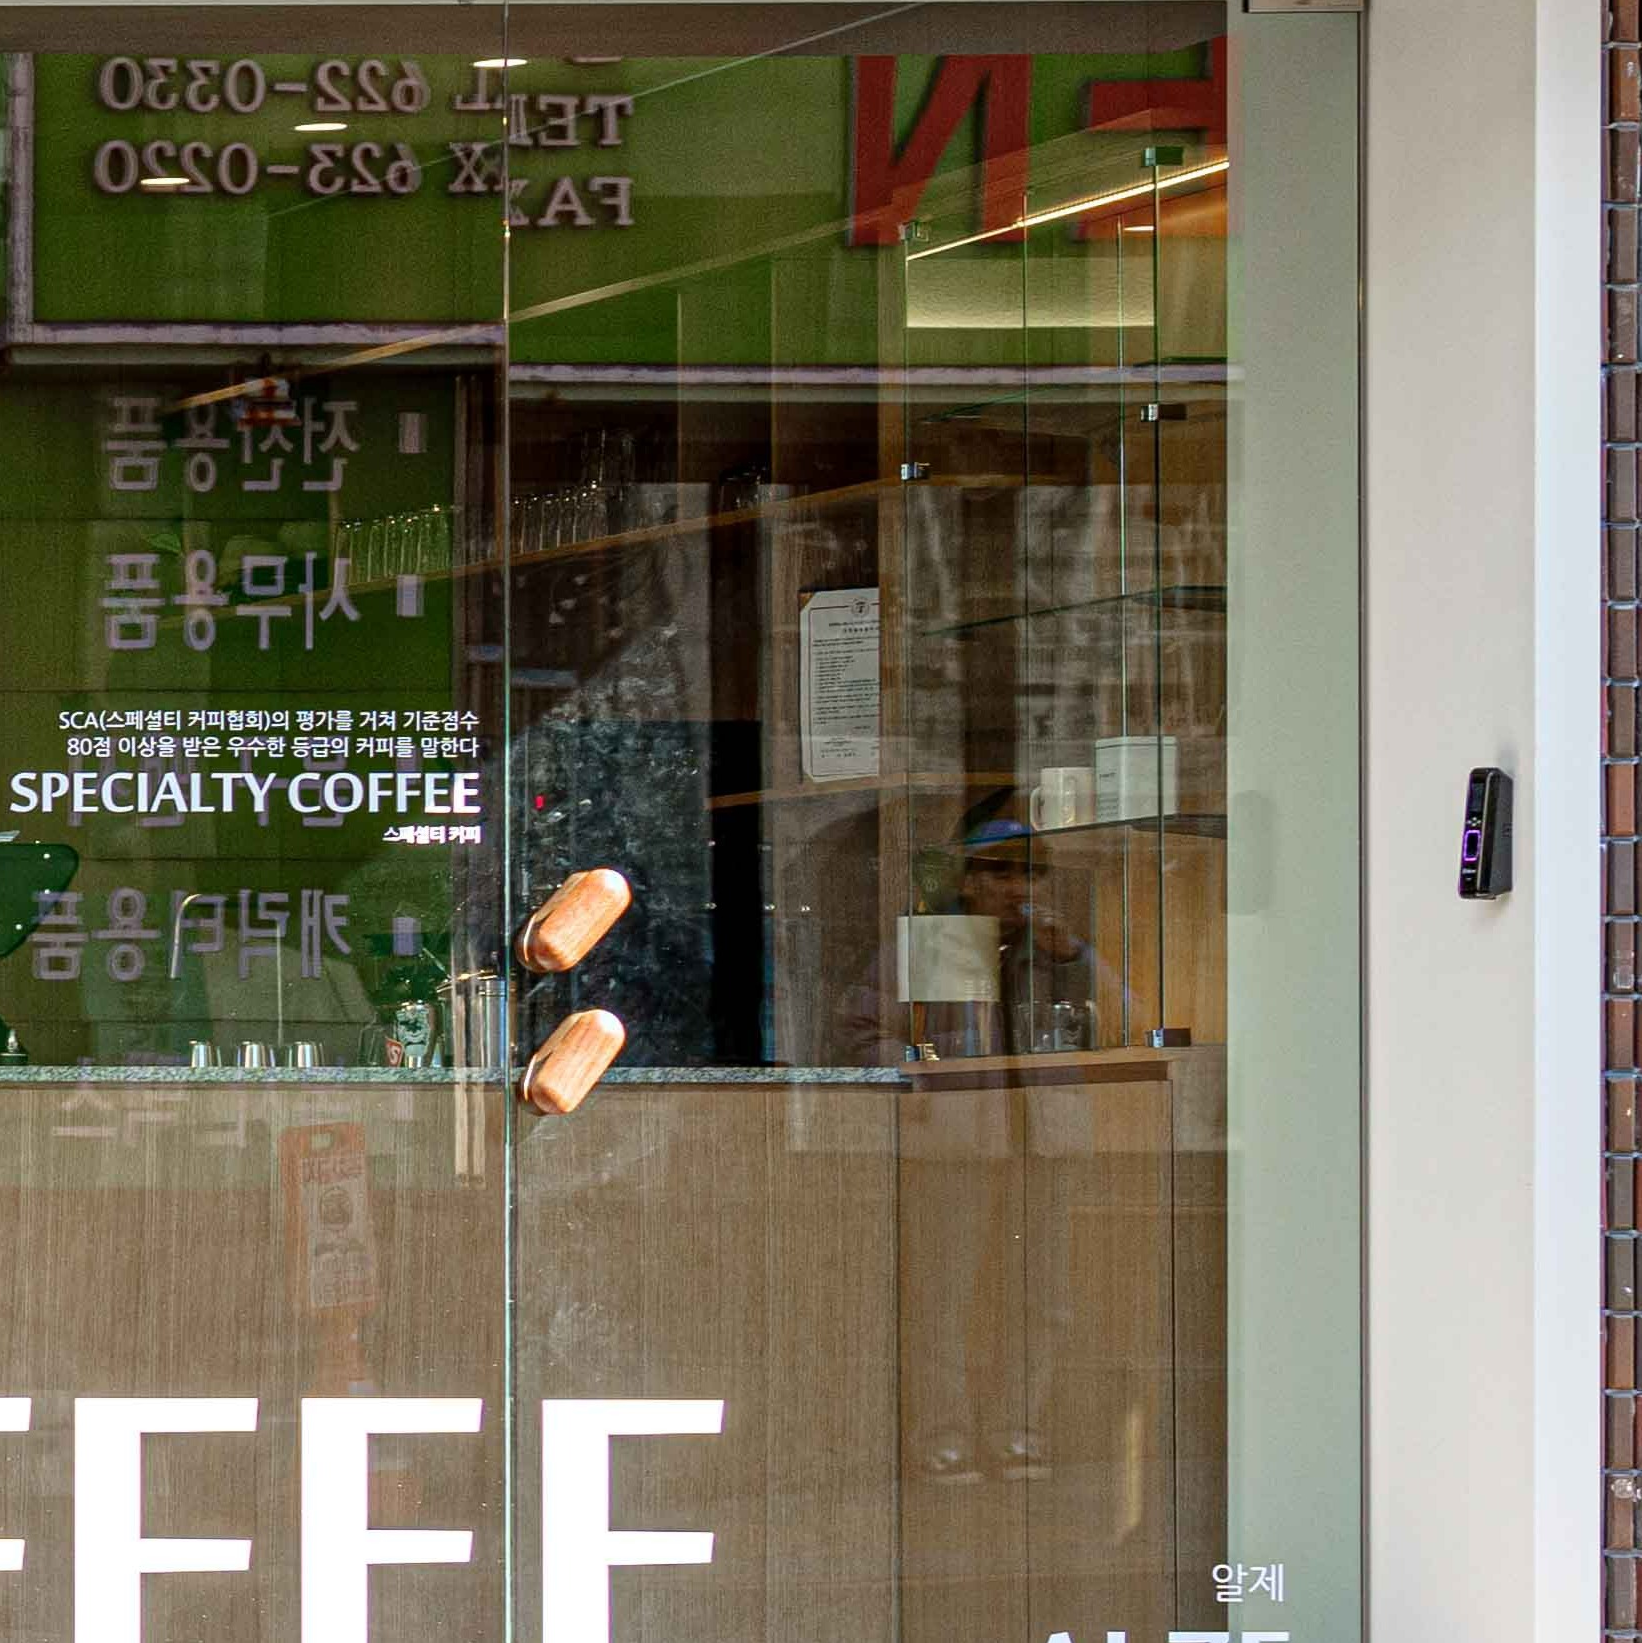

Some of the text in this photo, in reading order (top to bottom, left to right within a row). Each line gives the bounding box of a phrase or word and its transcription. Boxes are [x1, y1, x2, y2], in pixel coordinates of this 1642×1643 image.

[59, 709, 479, 732] SCA(스페셜티 커피협회)의 평가를 거쳐 기준점수
[67, 735, 480, 759] 80점 이상을 받은 우수한 등급의 커피를 말한다
[10, 772, 276, 813] SPECIALTY
[289, 772, 481, 814] COFFEE
[382, 825, 481, 844] 스페셜티 커피
[1211, 1562, 1285, 1603] 알제
